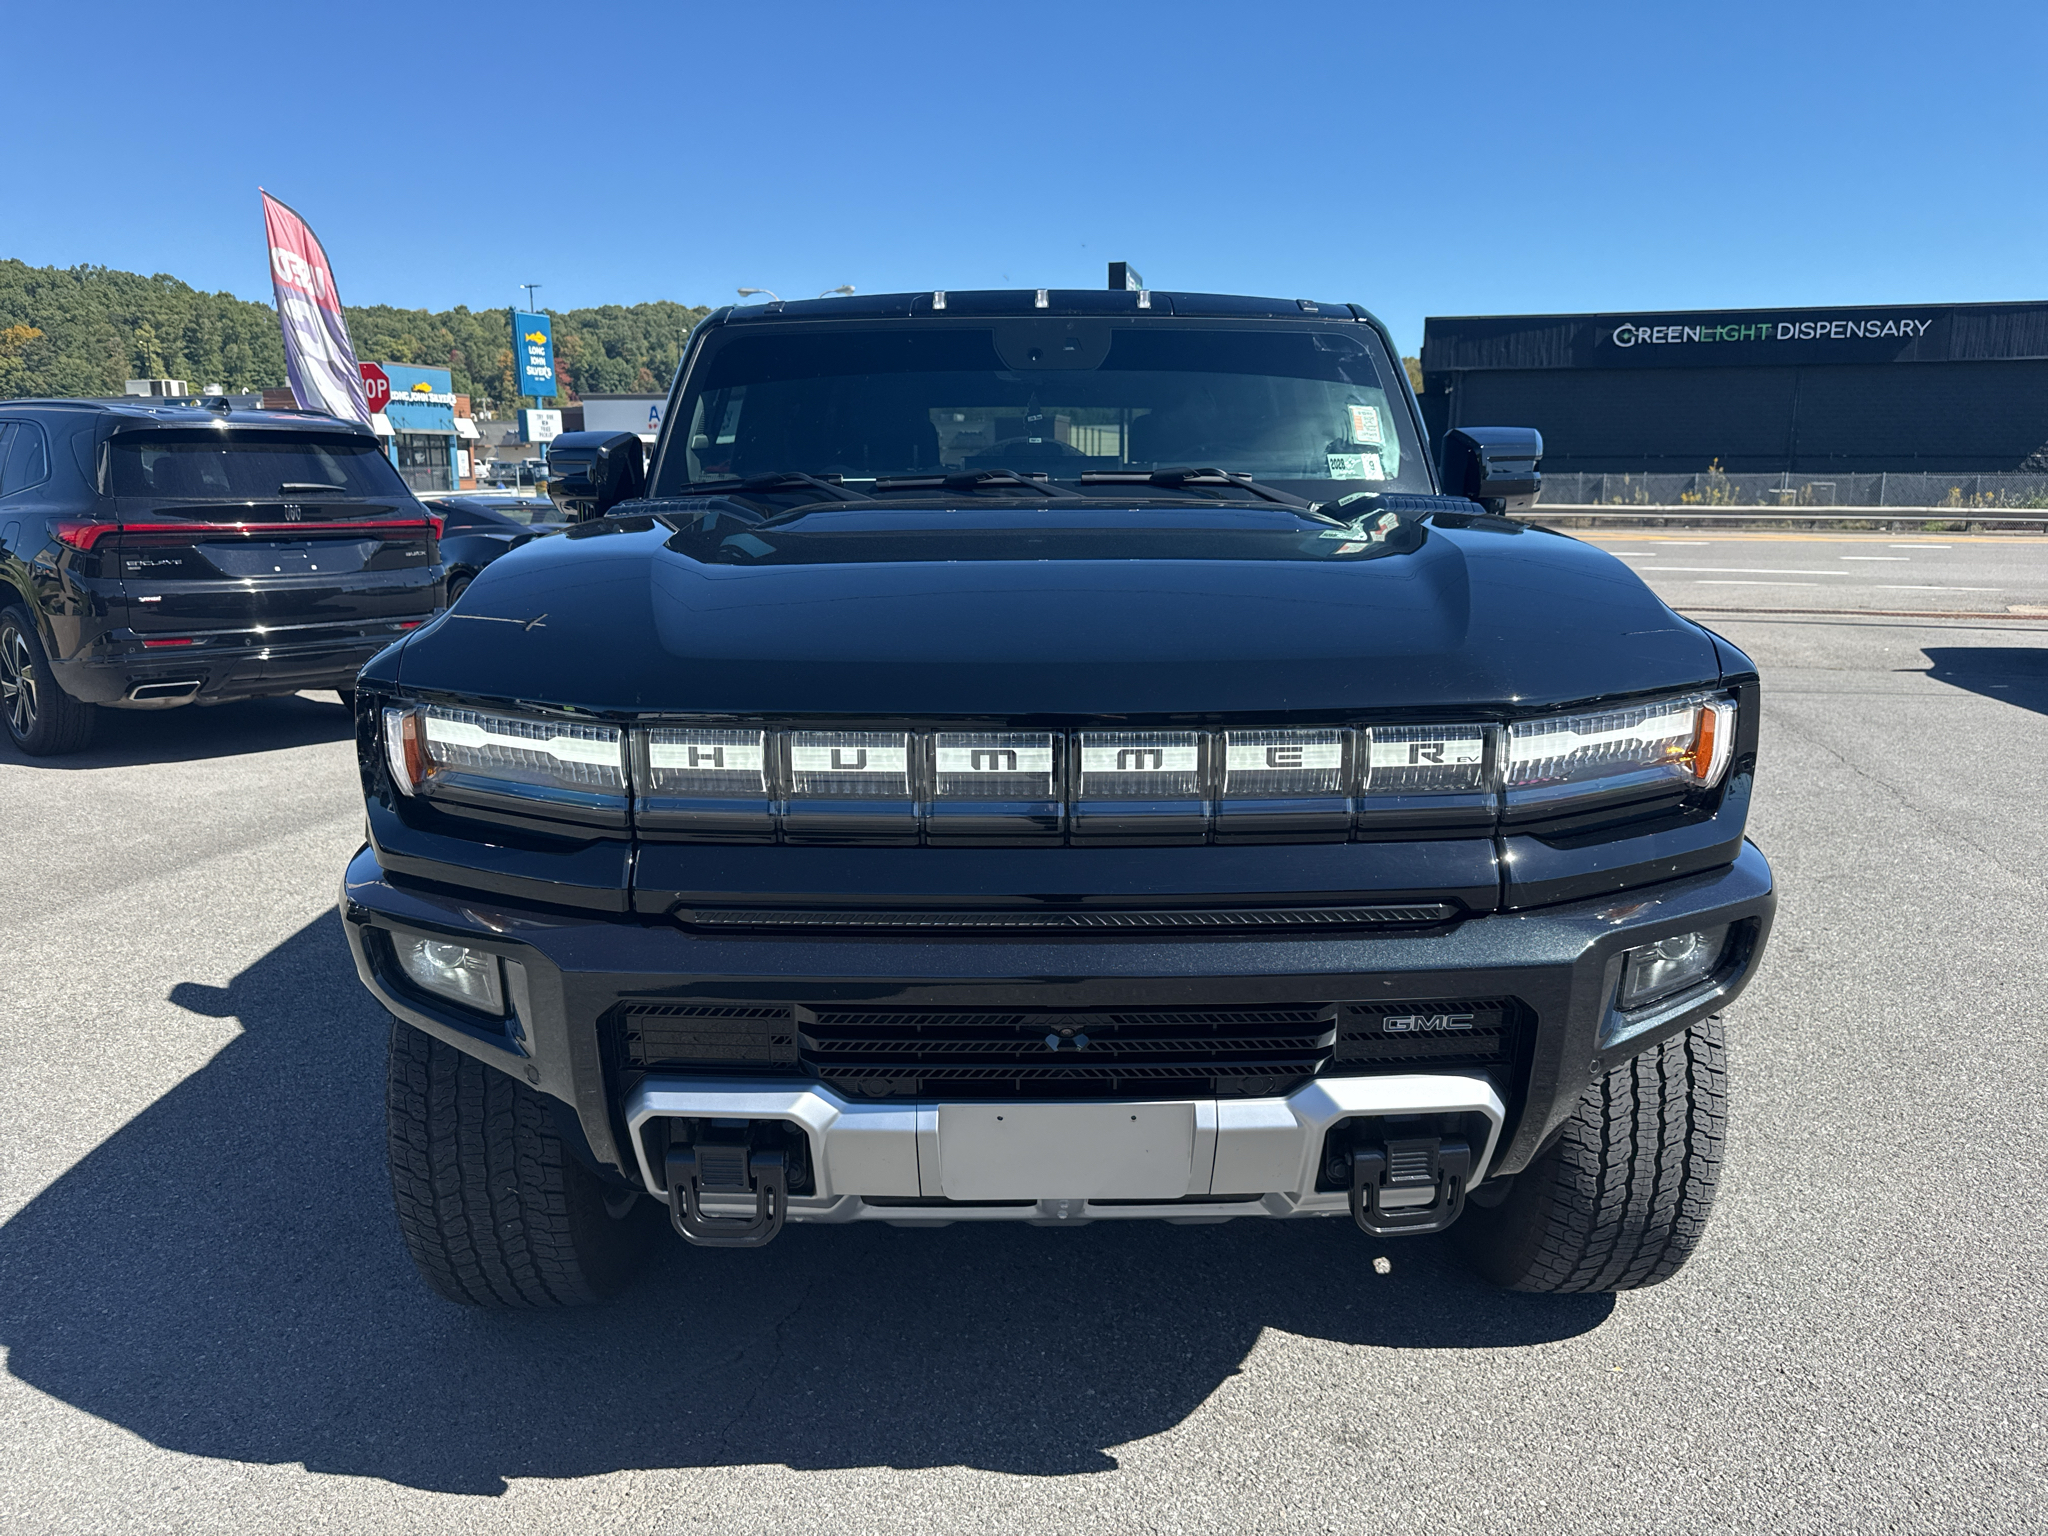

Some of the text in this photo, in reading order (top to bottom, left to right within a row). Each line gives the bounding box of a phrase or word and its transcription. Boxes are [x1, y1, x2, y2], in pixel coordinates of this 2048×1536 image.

[1612, 319, 1932, 347] GREENLIGHT DISPENSARY
[528, 345, 545, 356] LONG
[364, 378, 388, 399] OP
[390, 390, 410, 401] LONG
[410, 392, 428, 402] JOHN
[1457, 755, 1480, 763] EV
[1383, 1014, 1474, 1032] GMC
